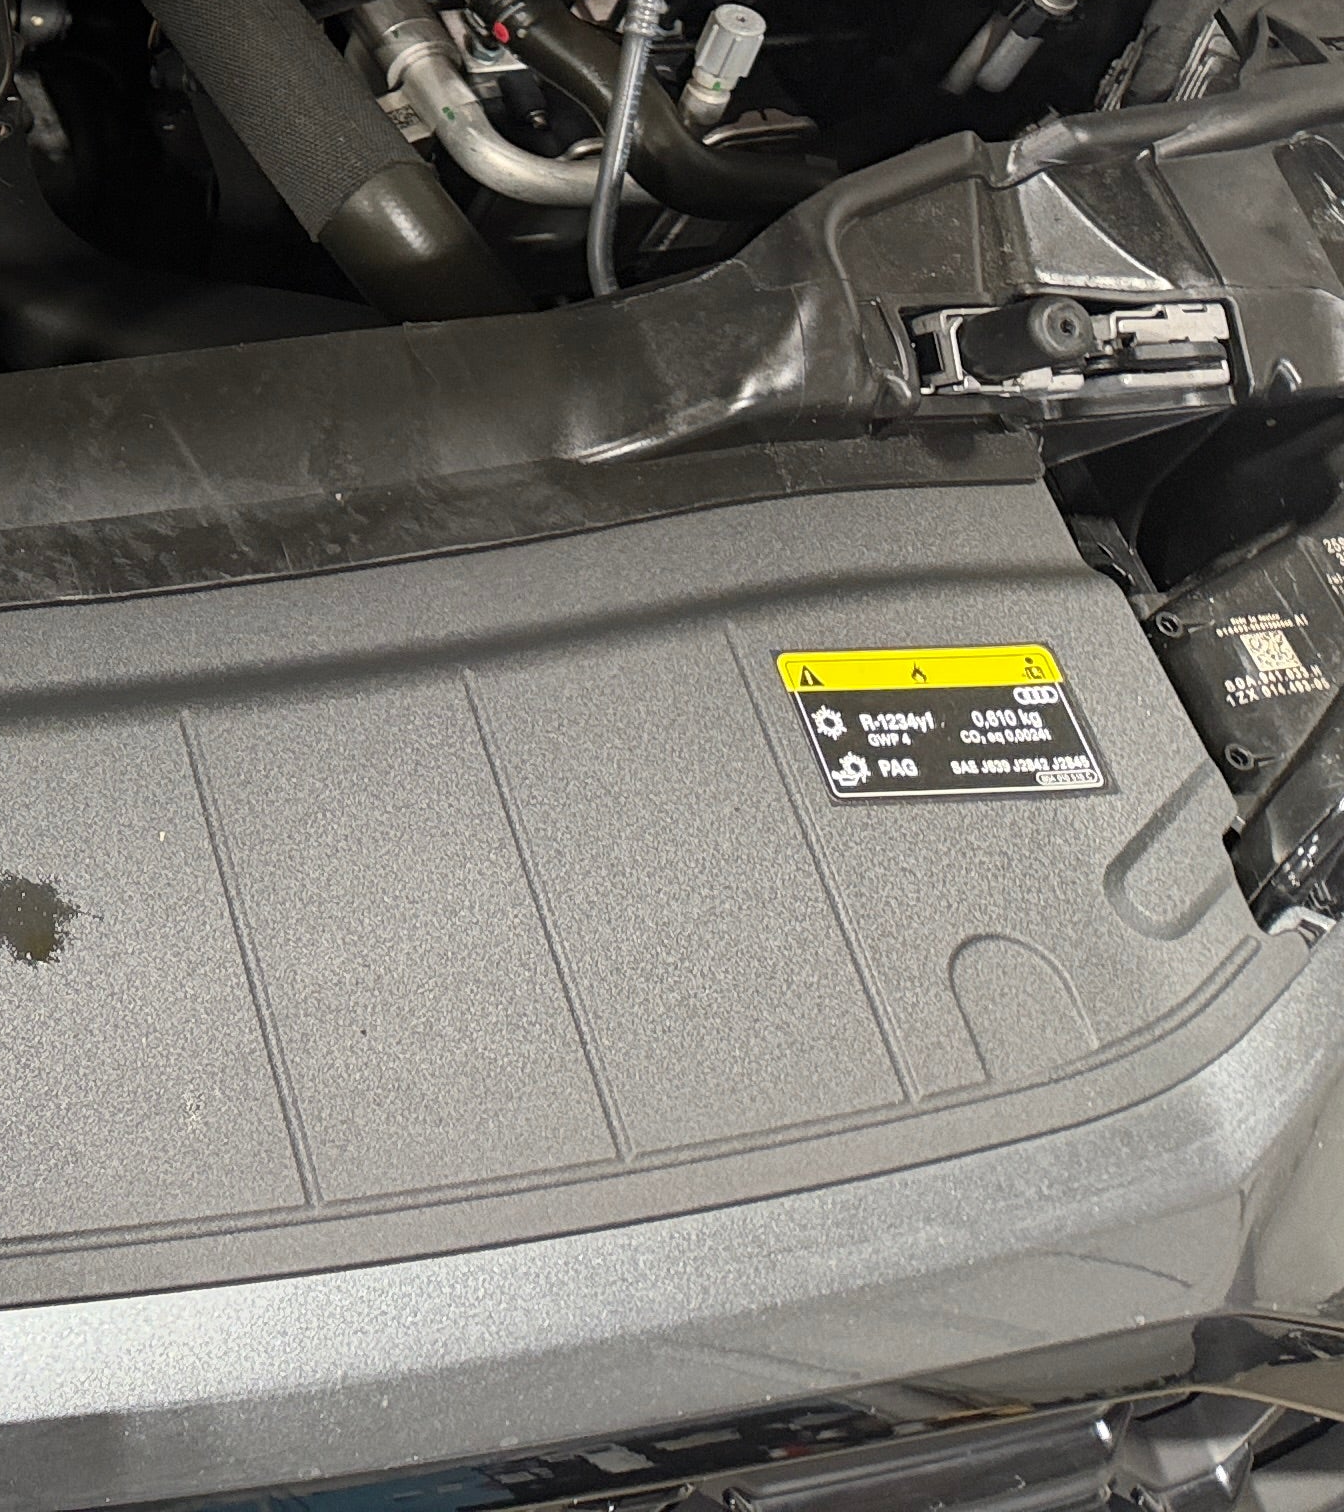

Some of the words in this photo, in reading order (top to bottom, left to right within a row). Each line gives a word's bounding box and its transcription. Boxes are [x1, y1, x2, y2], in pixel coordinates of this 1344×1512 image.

[1017, 708, 1043, 728] kg
[868, 733, 899, 747] GWP
[878, 759, 918, 777] PAG
